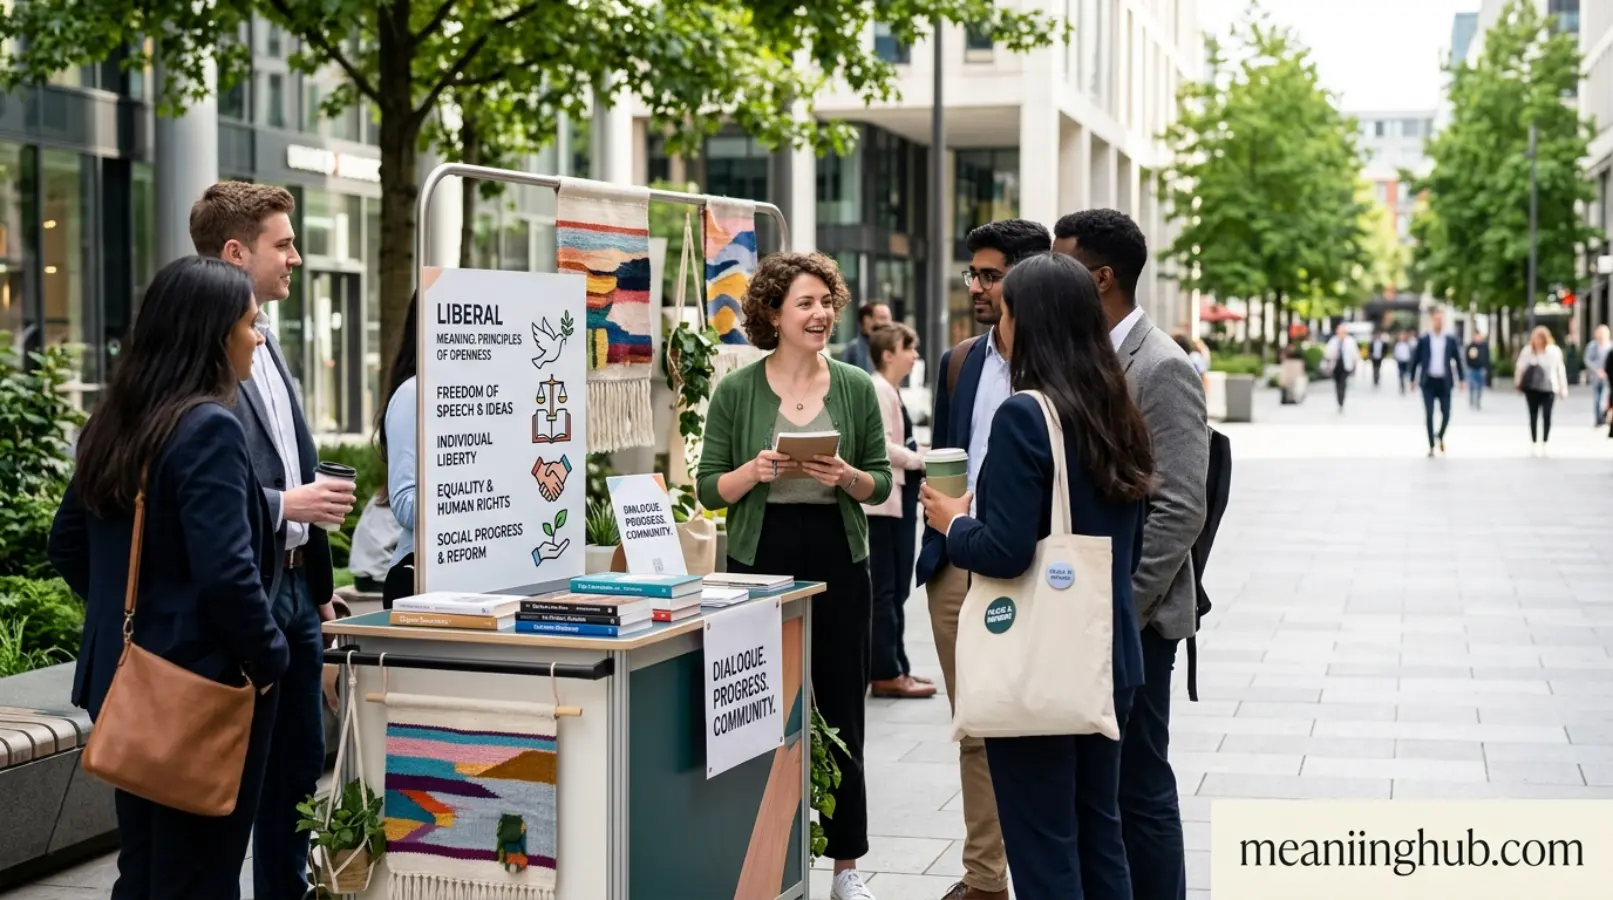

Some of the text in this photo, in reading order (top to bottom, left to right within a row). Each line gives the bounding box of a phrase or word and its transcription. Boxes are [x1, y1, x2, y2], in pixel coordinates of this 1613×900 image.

[437, 303, 503, 325] LIBERAL
[478, 334, 522, 345] PRINCIPLES
[450, 349, 491, 360] OPENNESS
[437, 384, 499, 399] FREEDOM OF
[437, 403, 474, 417] SPEECH
[486, 402, 513, 415] IDEAS
[437, 451, 477, 467] LIBERTY
[437, 479, 494, 499] EQUALITY &
[437, 495, 511, 516] HUMAN RIGHTS
[437, 523, 523, 546] SOCIAL PROGRESS
[437, 546, 487, 564] & REFORM
[713, 645, 767, 681] DIALOGUE.
[713, 672, 769, 709] PROGRESS.
[713, 694, 776, 736] COMMUNITY.
